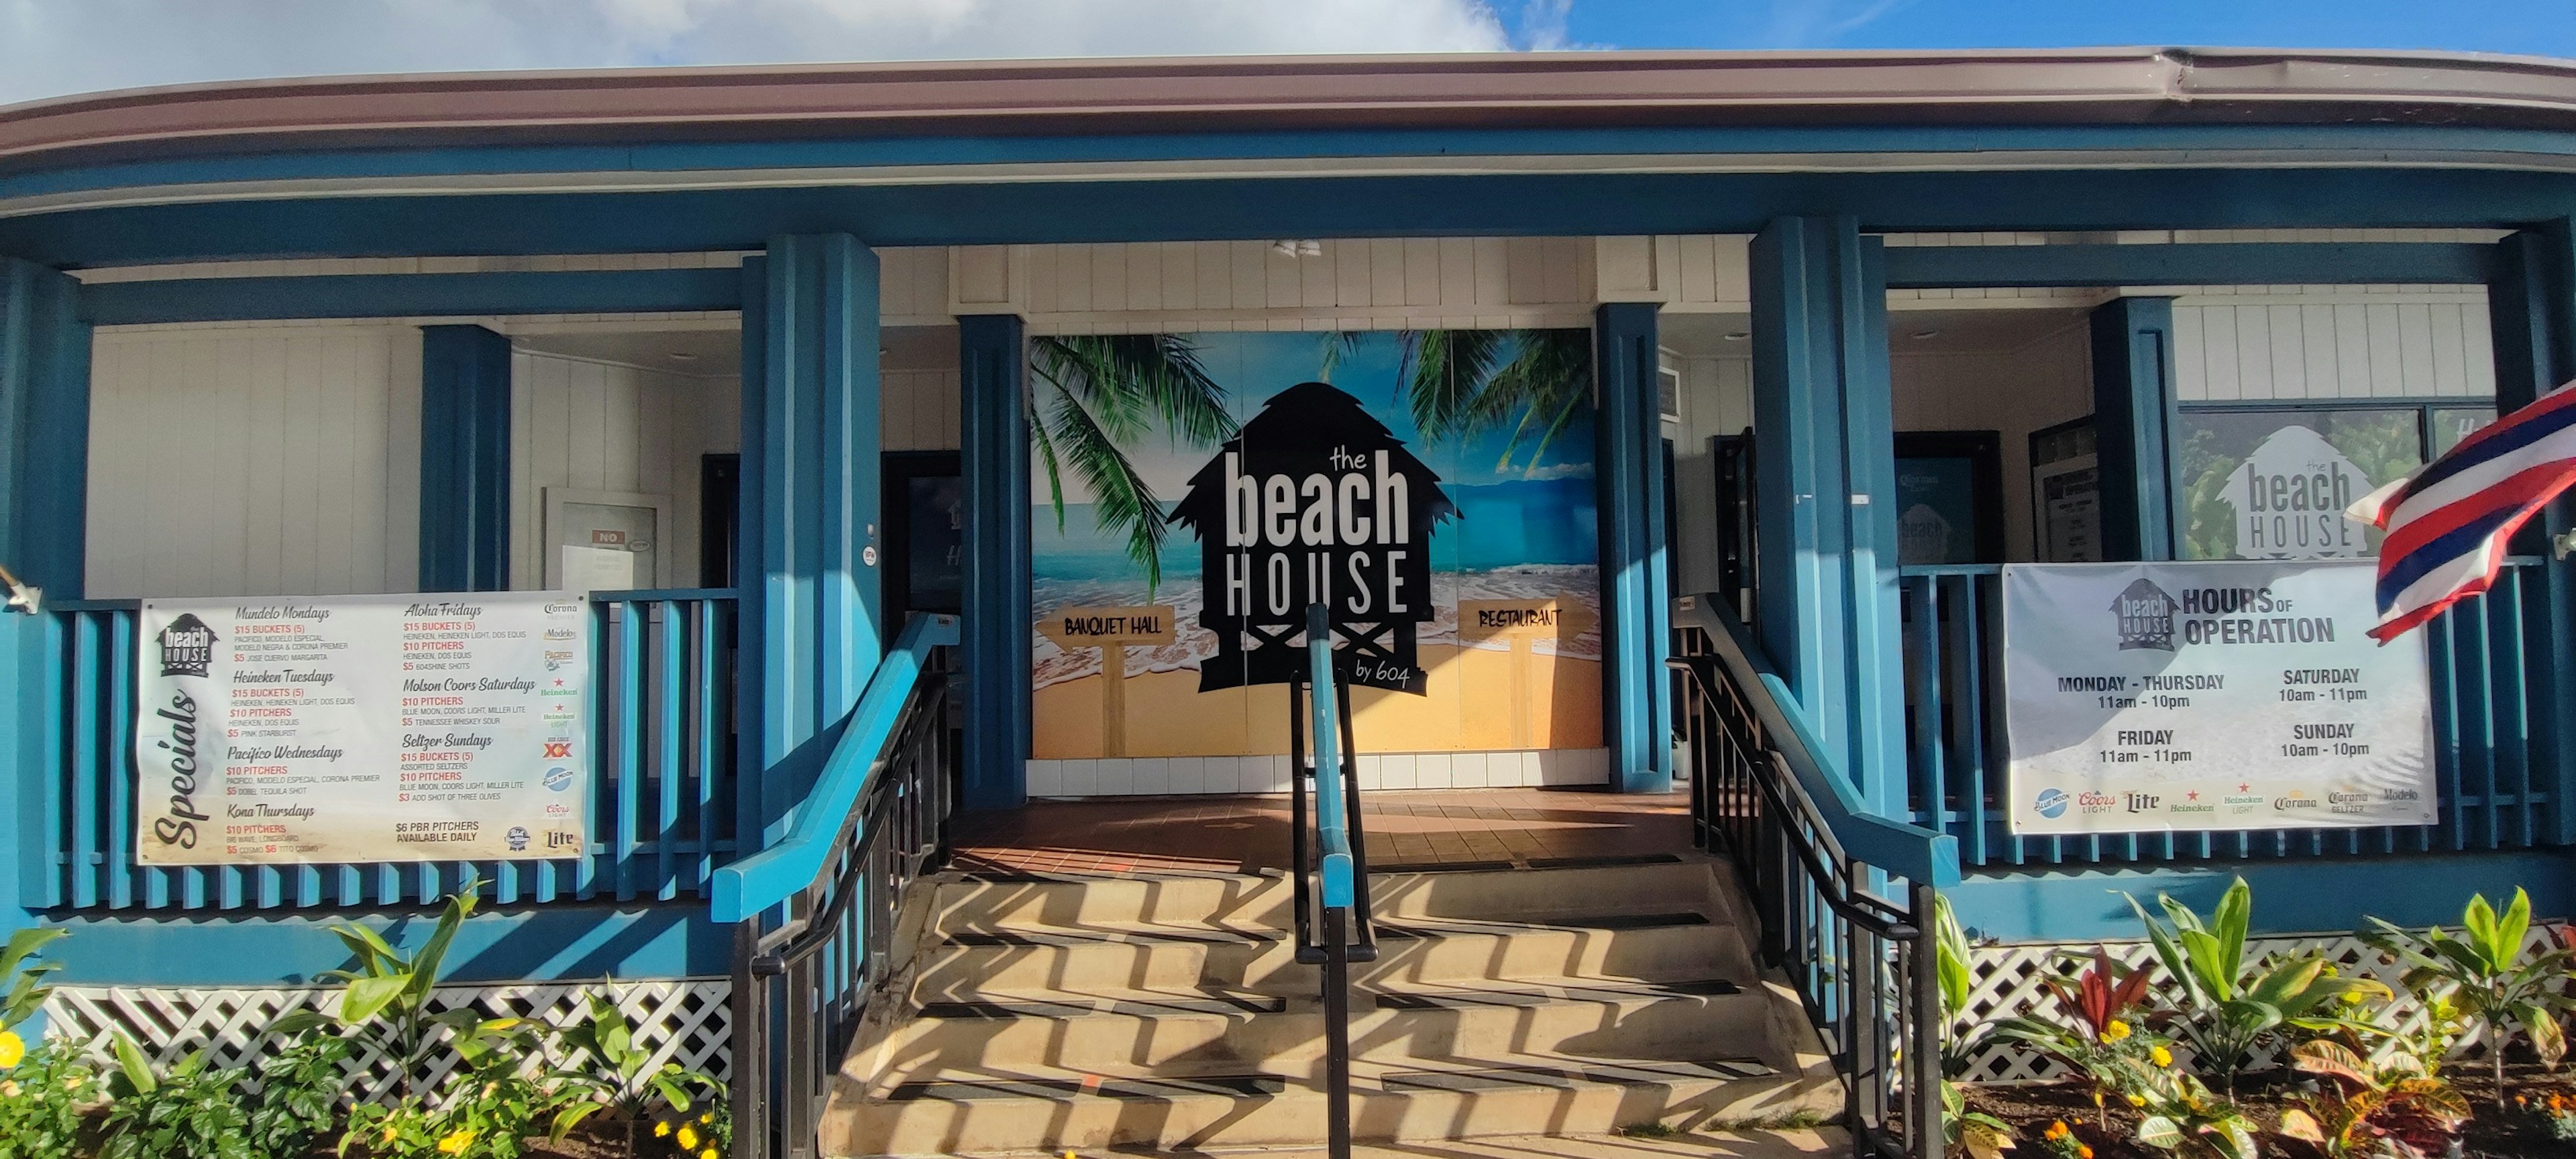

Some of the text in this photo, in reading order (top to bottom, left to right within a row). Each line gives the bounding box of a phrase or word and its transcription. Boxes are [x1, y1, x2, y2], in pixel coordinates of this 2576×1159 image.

[1329, 445, 1367, 471] the
[2306, 459, 2326, 472] the
[2248, 461, 2350, 512] beach
[1225, 449, 1409, 547] beach
[600, 533, 617, 542] NO
[2251, 515, 2351, 547] HOUSE
[1226, 551, 1407, 616] HOUSE
[2122, 594, 2167, 617] beach
[2183, 588, 2292, 614] HOURS OF
[235, 606, 331, 623] Mundelo Mondays
[405, 603, 483, 620] Aloha Fridays
[544, 604, 577, 614] Corona
[1065, 616, 1161, 635] BANQUET HALL
[1479, 609, 1562, 627] RESTAURANT
[235, 624, 305, 634] $15 BUCKETS (5)
[404, 622, 475, 631] $15 BUCKETS (5)
[2124, 618, 2169, 634] HOUSE
[2185, 618, 2334, 645] OPERATION
[165, 626, 208, 647] beach
[404, 642, 464, 651] $10 PITCHERS
[165, 648, 207, 661] HOUSE
[404, 663, 413, 671] $5
[1356, 659, 1410, 689] by 604
[233, 669, 335, 686] Heineken Tuesdays
[2058, 675, 2224, 692] MONDAY THURSDAY
[2284, 669, 2359, 684] SATURDAY
[232, 688, 303, 698] $15 BUCKETS (5)
[403, 677, 536, 694] Molson Coors Saturdays
[402, 697, 463, 706] $10 PITCHERS
[2098, 695, 2190, 710] 11am 10pm
[2279, 687, 2367, 703] 10am 11pm
[230, 708, 291, 717] $10 PITCHERS
[227, 729, 239, 737] $5
[2118, 730, 2174, 745] FRIDAY
[2294, 724, 2354, 739] SUNDAY
[402, 733, 493, 751] Seltzer Sundays
[2282, 742, 2369, 757] 10am 10pm
[227, 745, 343, 763] Pacifico Wednesdays
[401, 752, 473, 762] $15 BUCKETS (5)
[2100, 749, 2192, 764] 11am 11pm
[155, 688, 209, 849] Specials
[227, 766, 287, 775] $10 PITCHERS
[400, 772, 462, 781] $10 PITCHERS
[227, 787, 237, 795] $5
[398, 793, 409, 802] $3
[2079, 791, 2116, 806] Coors
[2328, 791, 2367, 804] Corona
[2384, 788, 2418, 801] Modelo
[2052, 793, 2070, 805] MOON
[2127, 793, 2159, 813] Lite
[2224, 796, 2263, 804] Heineken
[2274, 797, 2317, 812] Corona
[227, 804, 317, 820] Kona Thursdays
[2170, 804, 2214, 812] Heineken
[2233, 806, 2254, 814] LIGHT
[227, 825, 286, 834] $10 PITCHERS
[396, 822, 479, 832] $6 PBR PITCHERS
[397, 832, 477, 842] AVAILABLE DAILY
[547, 832, 573, 848] Lite
[227, 846, 237, 854] $5
